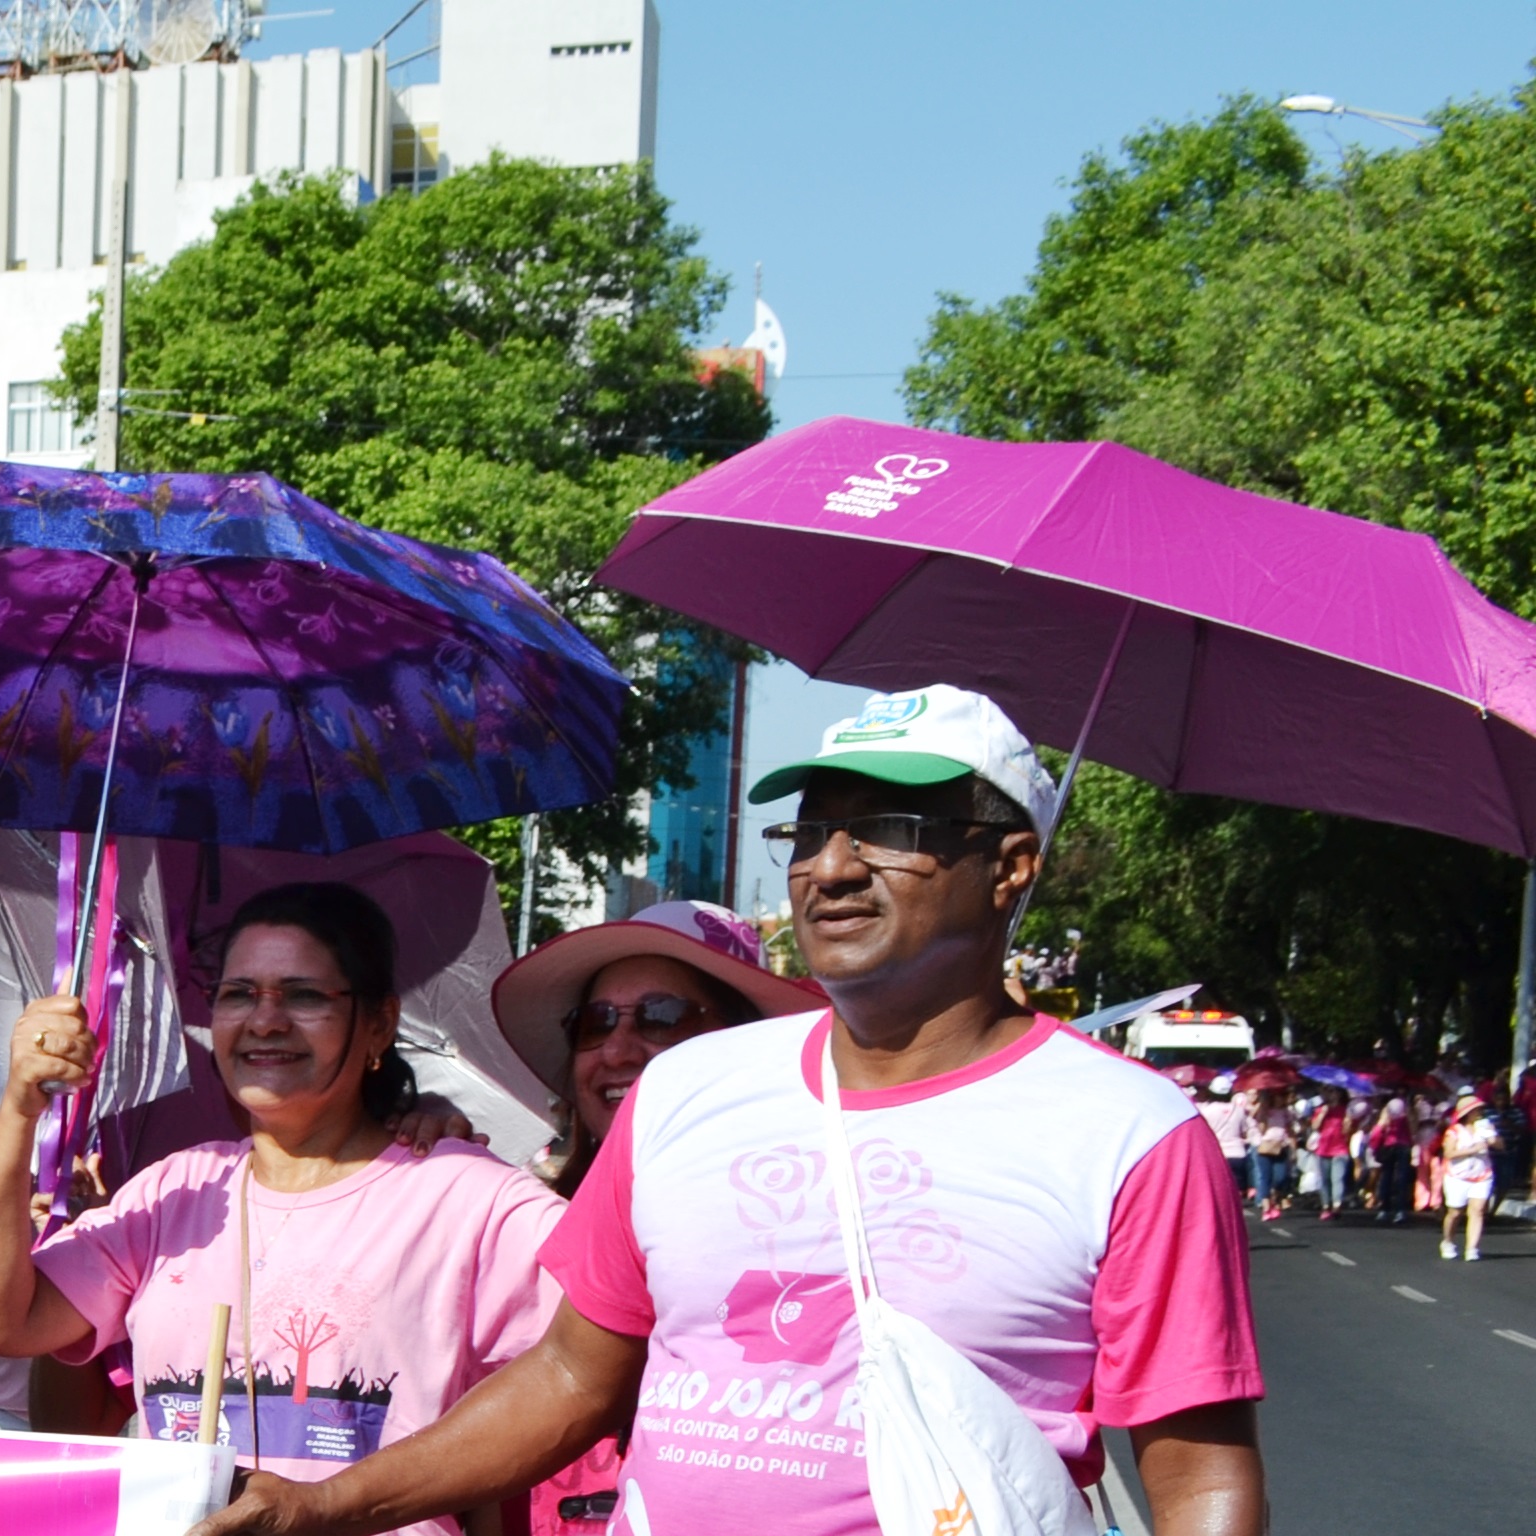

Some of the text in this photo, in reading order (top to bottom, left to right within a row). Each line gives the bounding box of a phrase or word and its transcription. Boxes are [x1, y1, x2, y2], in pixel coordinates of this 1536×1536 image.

[708, 1368, 824, 1422] JOÃO
[673, 1418, 740, 1442] CONTRA
[743, 1427, 759, 1442] O
[764, 1424, 848, 1455] CÂNCER
[686, 1447, 732, 1469] JOÃO
[734, 1456, 764, 1473] DO
[767, 1459, 828, 1480] PIAUÍ
